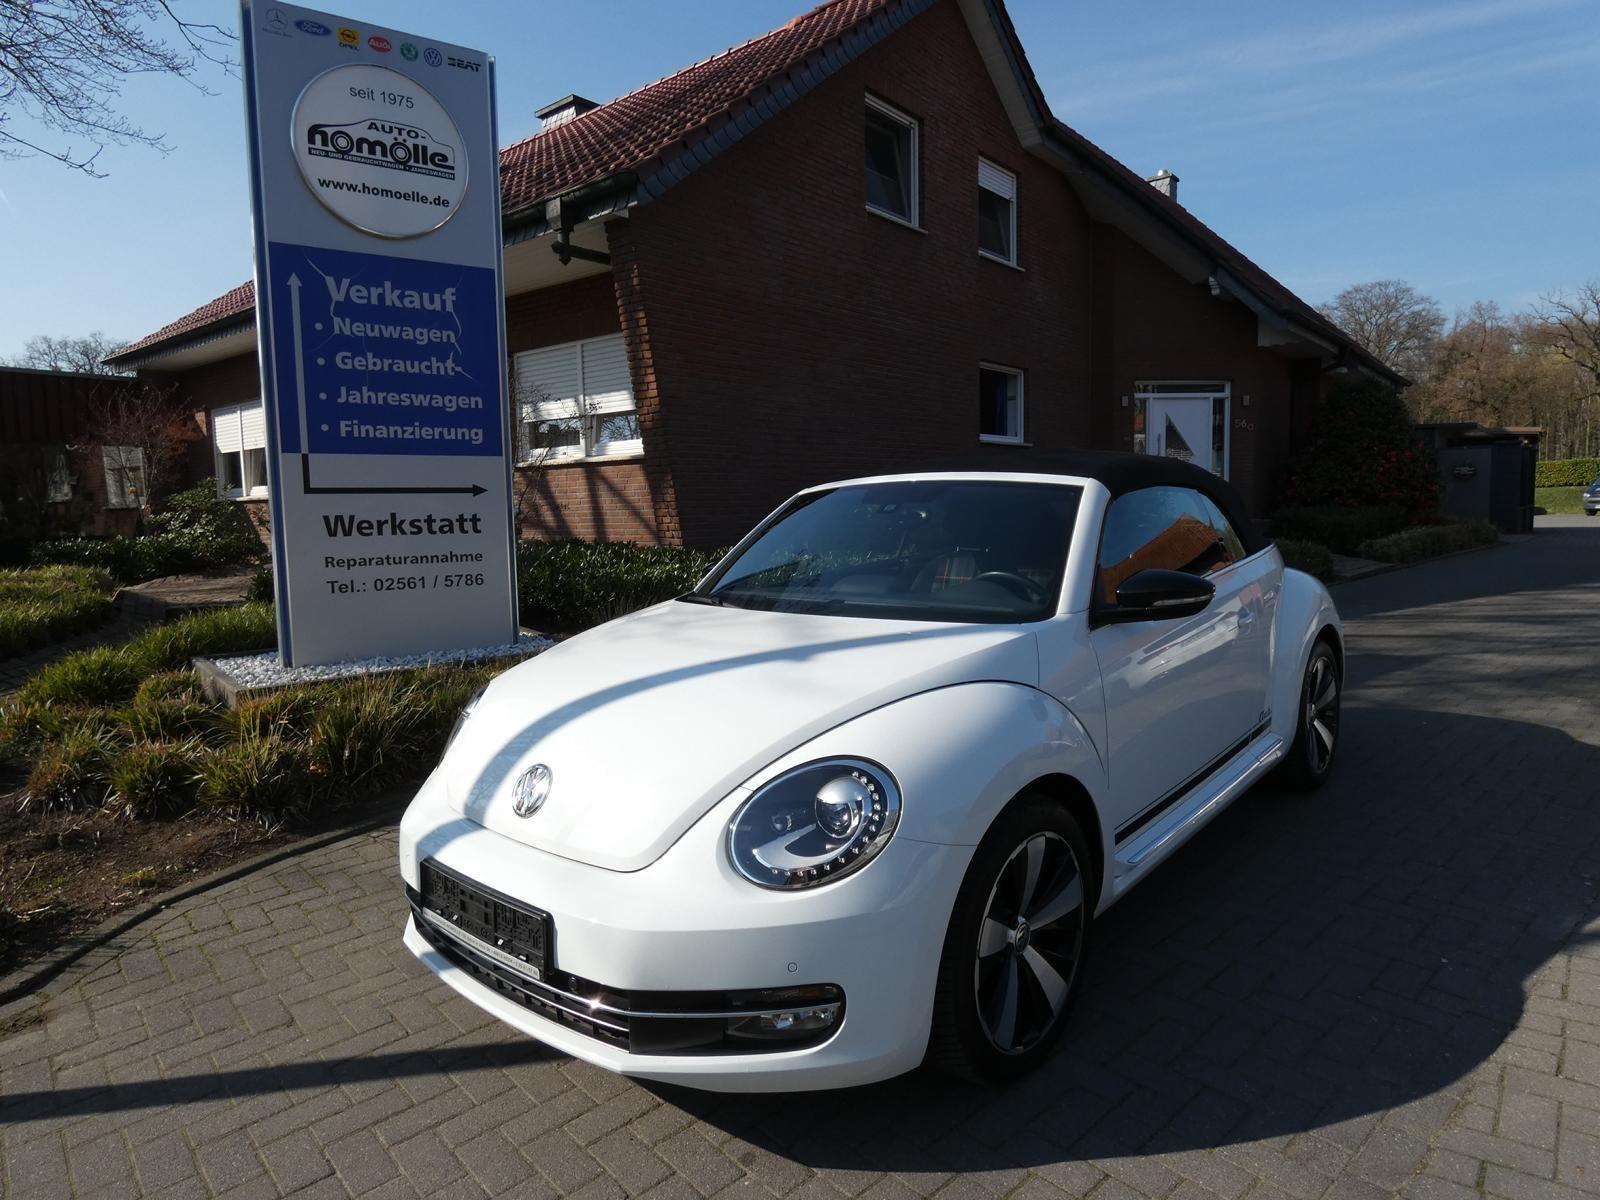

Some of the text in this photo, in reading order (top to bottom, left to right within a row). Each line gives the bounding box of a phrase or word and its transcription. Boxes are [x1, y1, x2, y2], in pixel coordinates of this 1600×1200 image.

[447, 57, 481, 72] SEAT
[349, 87, 414, 109] seit 1975
[367, 122, 426, 139] AUTO-
[329, 150, 343, 159] UND
[344, 154, 404, 170] GEBRAUCHTWAGEN
[410, 165, 454, 179] JAHRESWAGEN
[317, 178, 450, 208] www.homoelle.de
[325, 276, 457, 312] Verkauf
[333, 317, 456, 345] Neuwagen
[337, 386, 483, 411] Jahreswagen
[339, 420, 483, 444] Finanzierung
[323, 513, 482, 537] Werkstatt
[324, 551, 483, 570] Reparaturannahme
[326, 573, 485, 594] Tel.: 02561 / 5786
